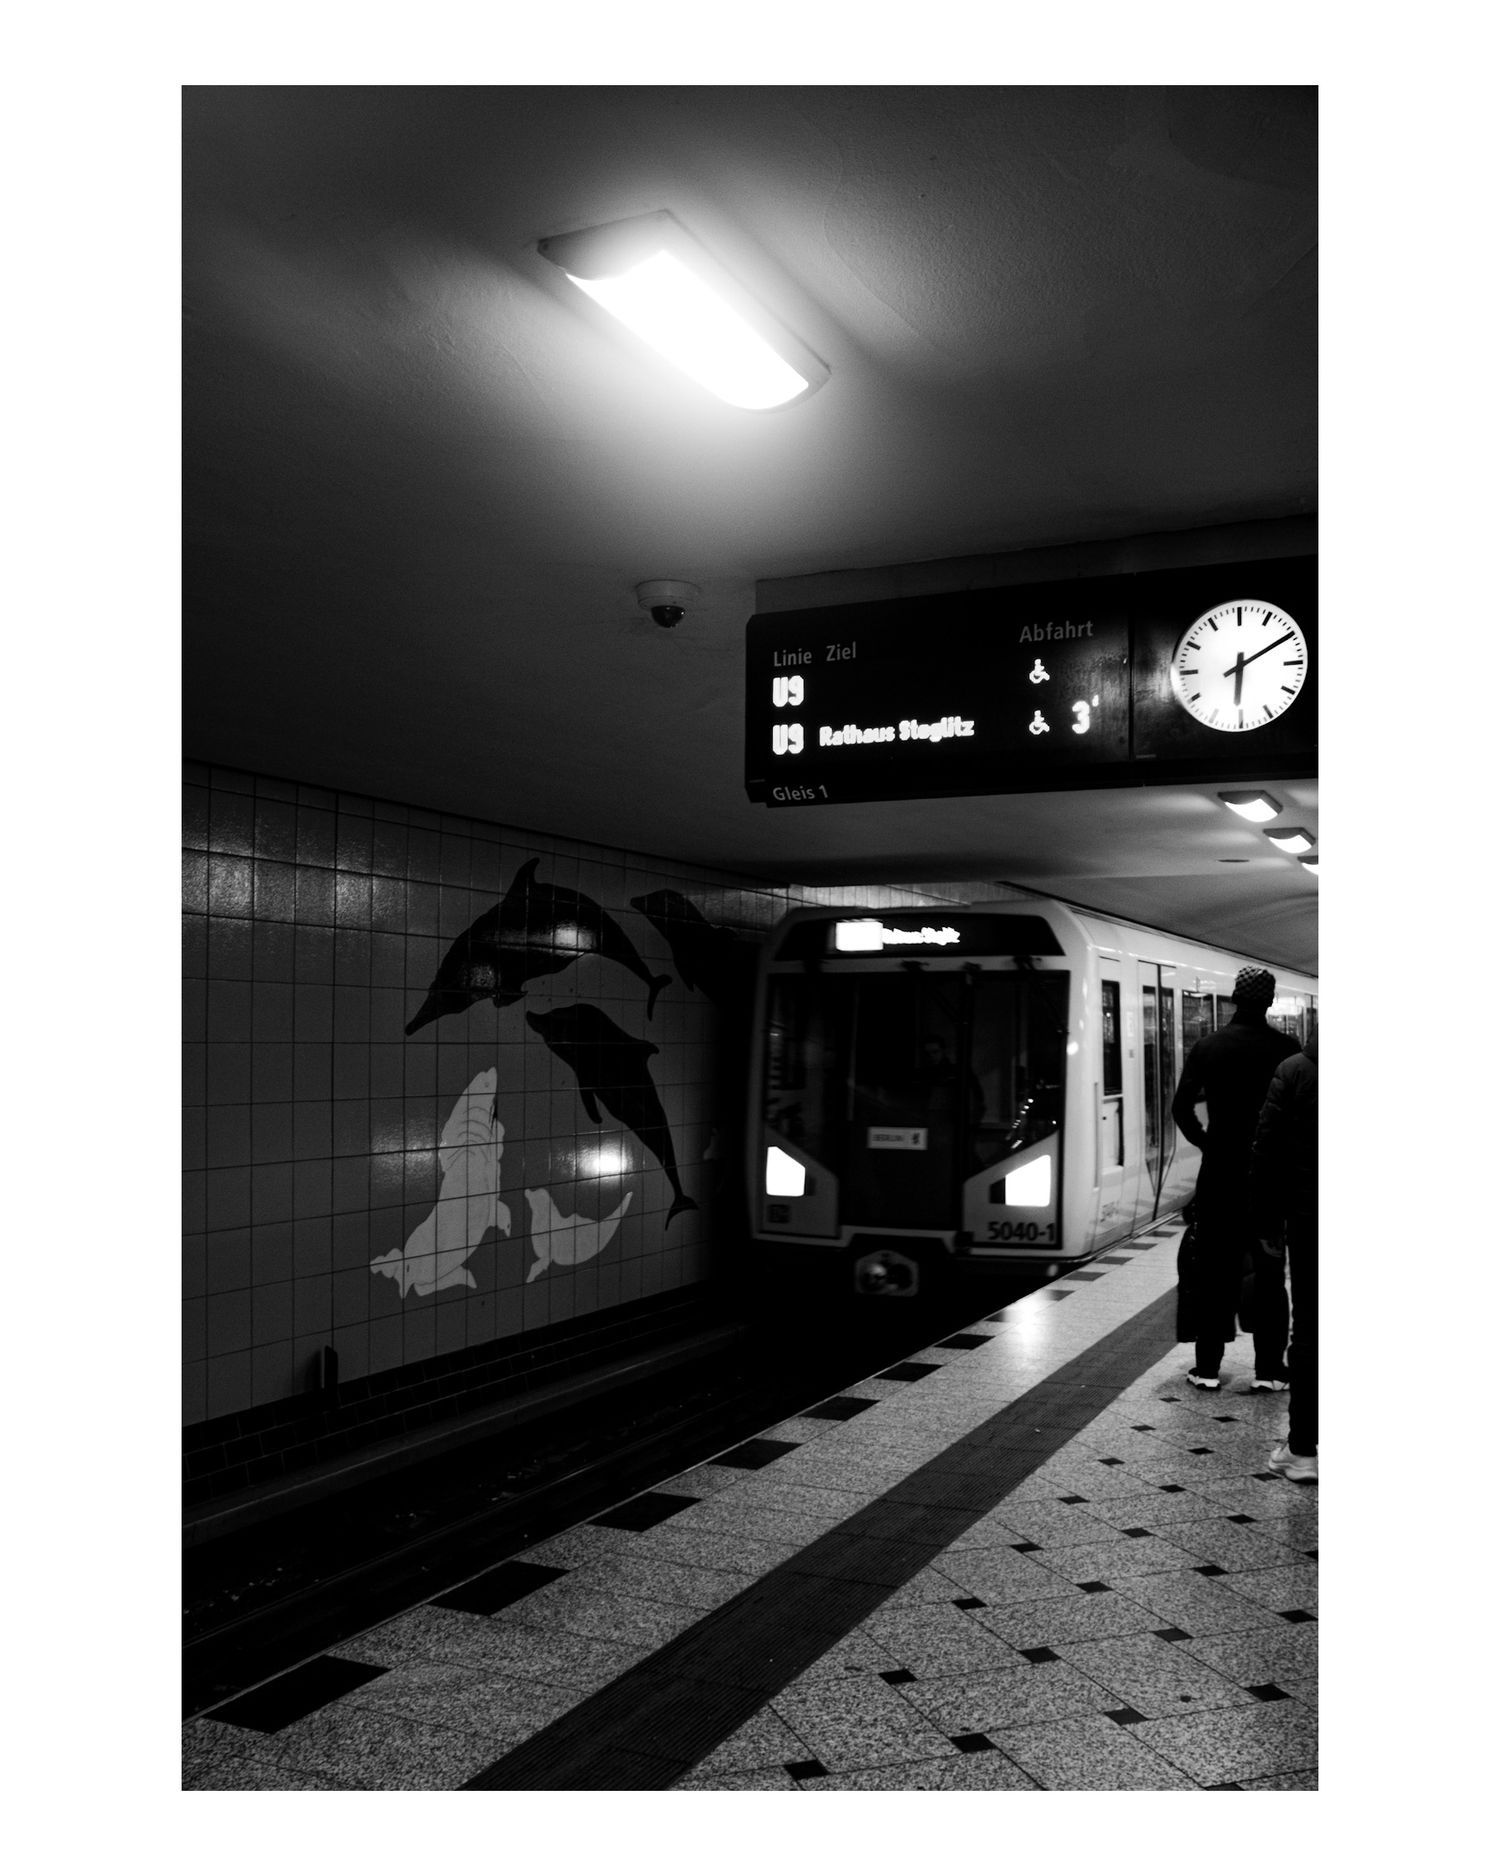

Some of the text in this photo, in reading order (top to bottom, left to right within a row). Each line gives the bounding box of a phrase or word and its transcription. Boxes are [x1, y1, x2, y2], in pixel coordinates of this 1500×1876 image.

[773, 620, 1094, 667] Linie Ziel Abfahrt
[772, 675, 804, 707] U9
[772, 723, 804, 755] U9
[819, 724, 896, 747] Rathaus
[772, 784, 829, 801] Gleis 1
[988, 1221, 1056, 1241] 5040-1
